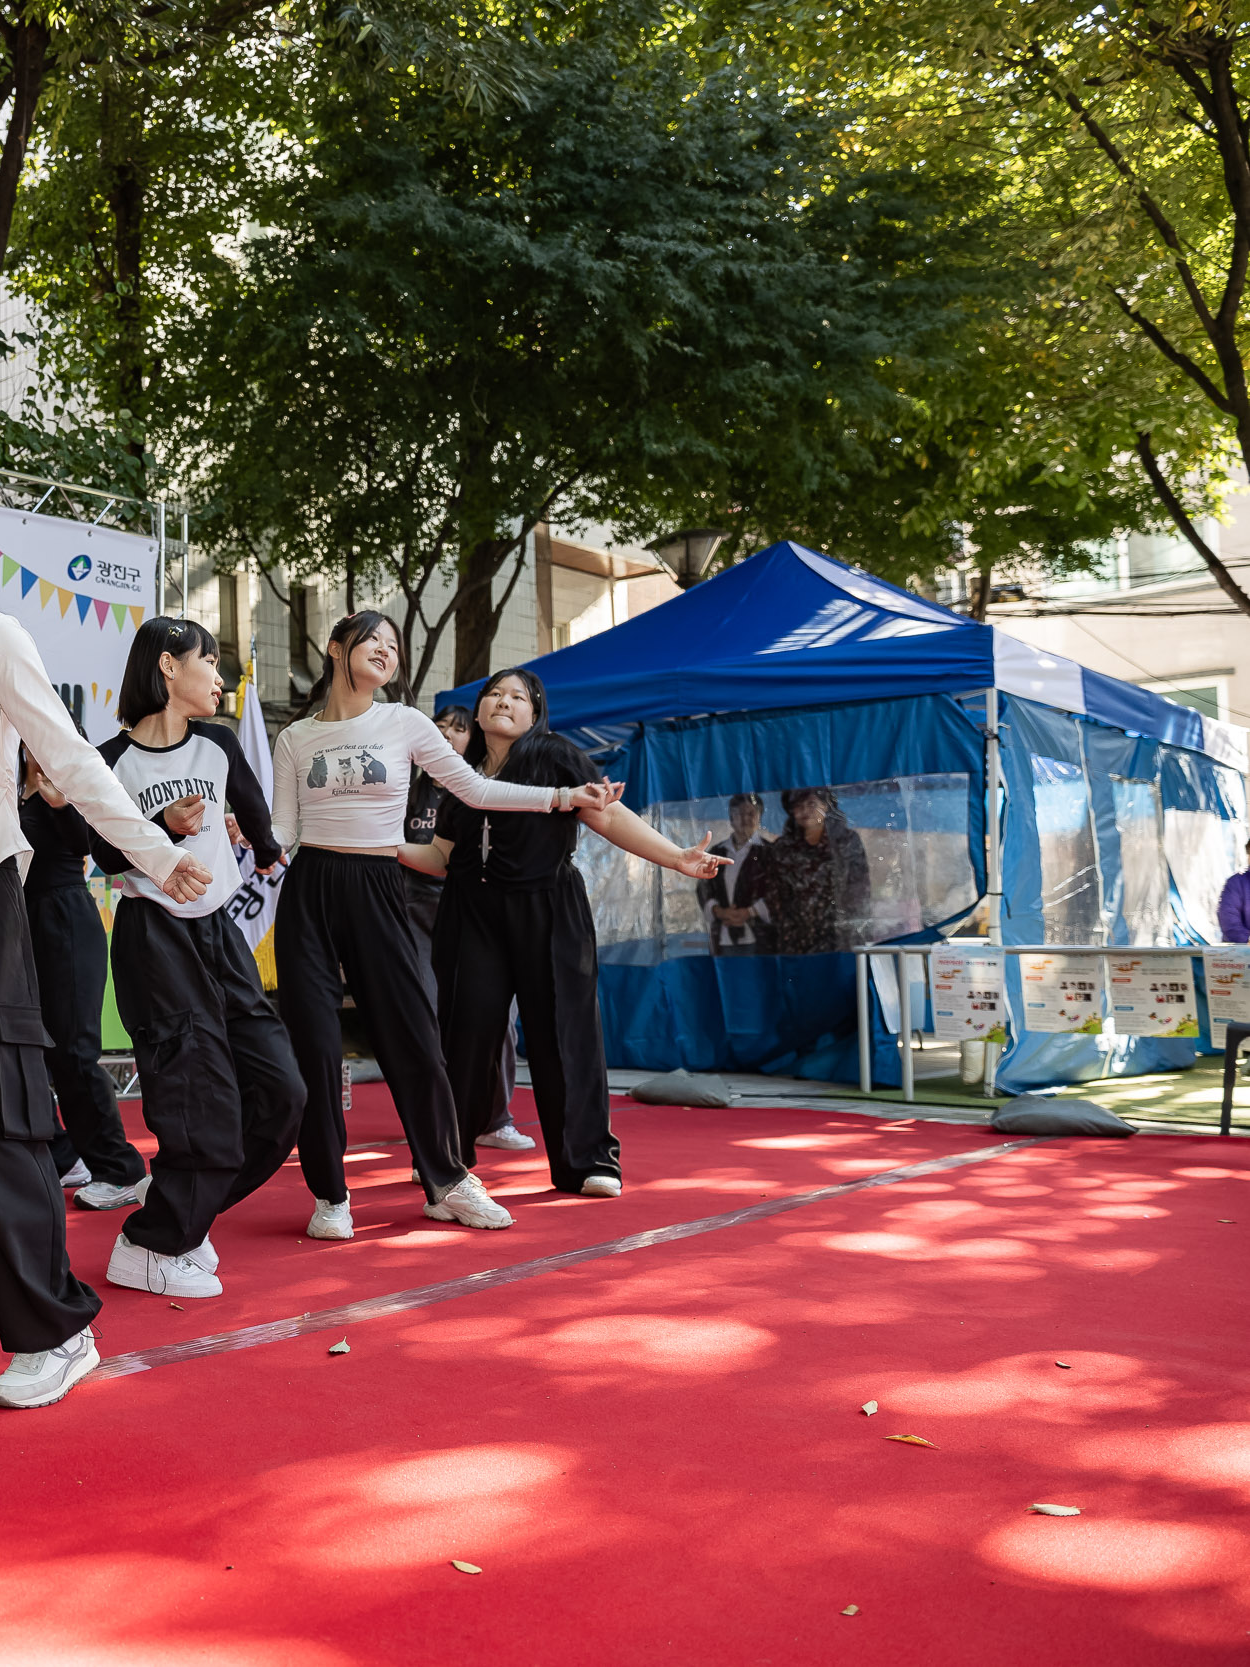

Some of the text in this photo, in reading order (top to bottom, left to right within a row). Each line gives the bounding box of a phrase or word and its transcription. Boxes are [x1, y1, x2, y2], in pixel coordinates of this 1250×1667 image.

[97, 560, 141, 582] 광진구
[138, 778, 217, 814] MONTAUK
[332, 788, 360, 796] kindness
[427, 808, 437, 818] D
[411, 817, 436, 830] Ord
